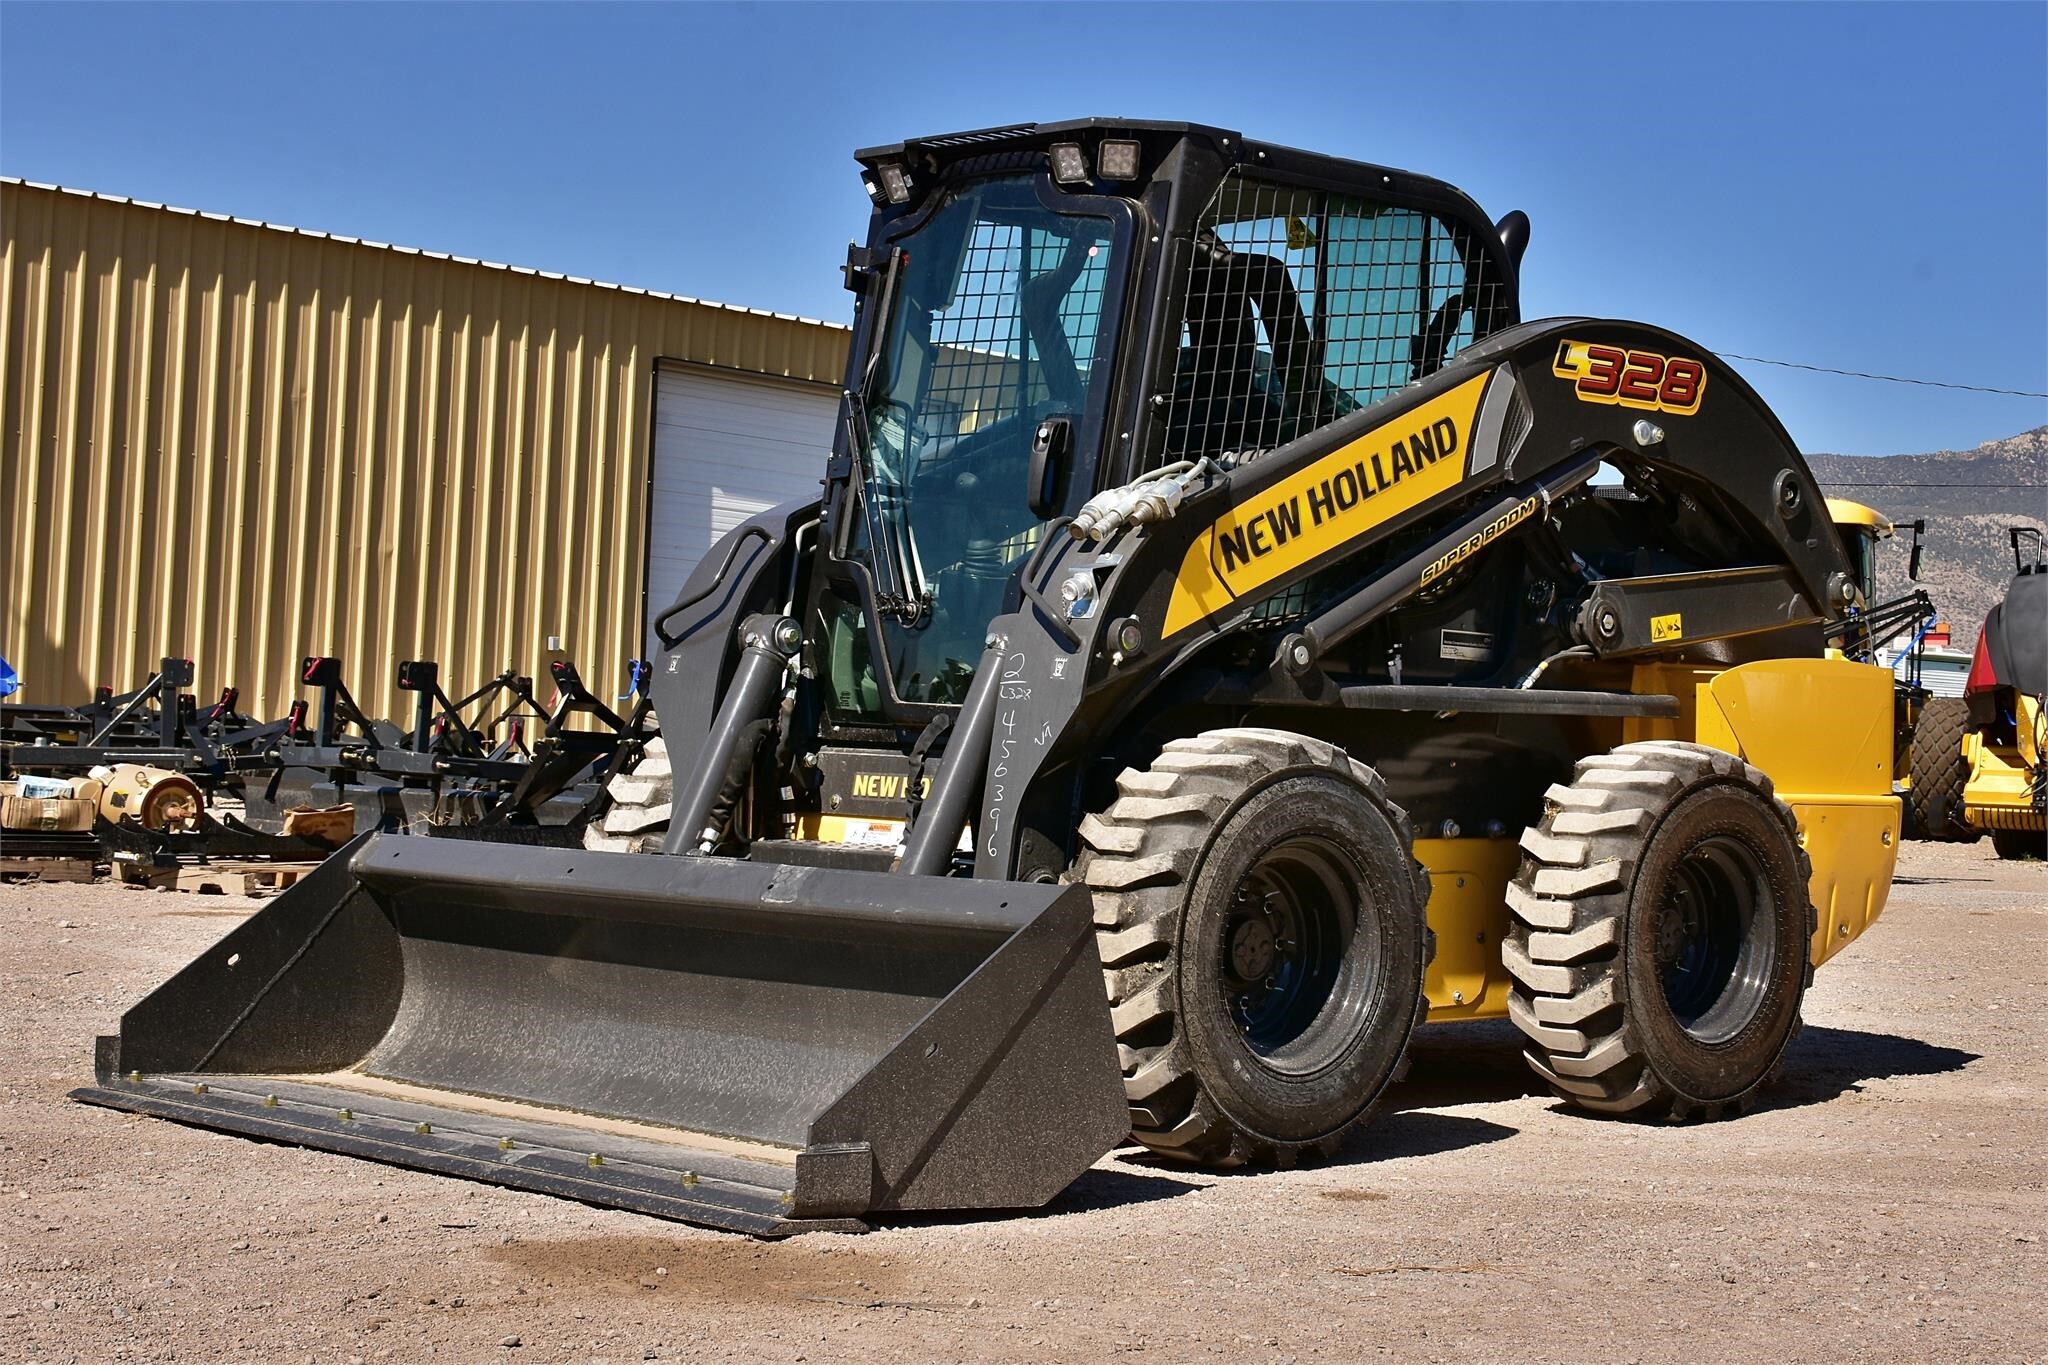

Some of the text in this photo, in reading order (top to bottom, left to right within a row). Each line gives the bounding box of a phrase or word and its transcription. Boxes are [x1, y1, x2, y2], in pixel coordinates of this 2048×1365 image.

[1552, 339, 1707, 416] L328
[1218, 416, 1458, 574] NEW HOLLAND
[1420, 497, 1536, 588] SUPER BOOM
[1003, 652, 1026, 679] 2
[852, 774, 899, 799] NEW
